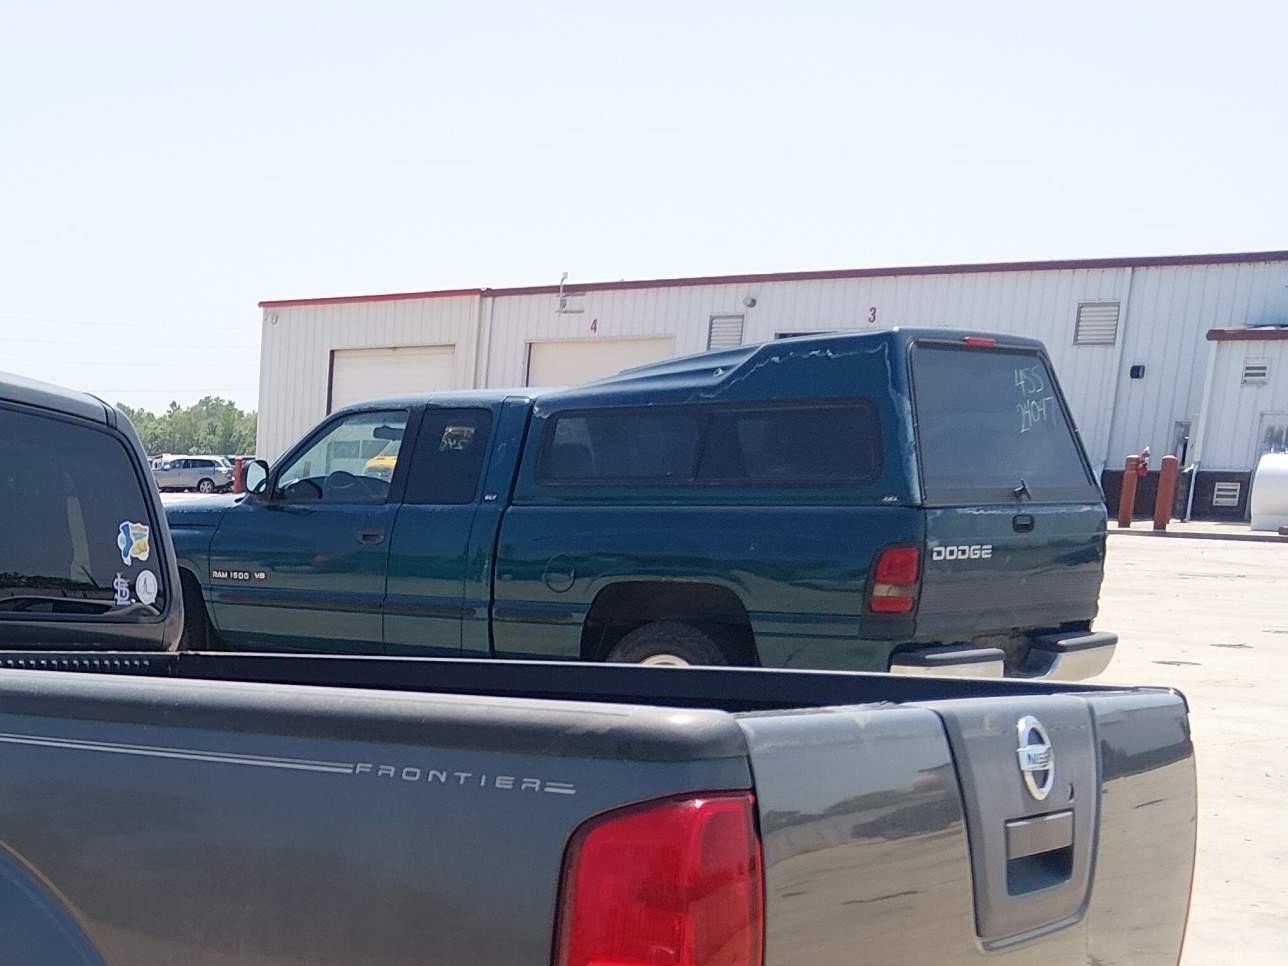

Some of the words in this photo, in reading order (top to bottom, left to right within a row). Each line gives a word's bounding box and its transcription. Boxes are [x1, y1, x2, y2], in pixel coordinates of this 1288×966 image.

[868, 306, 877, 323] 3
[590, 318, 598, 333] 4
[1015, 367, 1045, 395] 455
[932, 544, 993, 560] DODGE
[212, 570, 228, 578] RAM
[229, 572, 249, 580] 1500
[355, 762, 541, 792] FRONTIER
